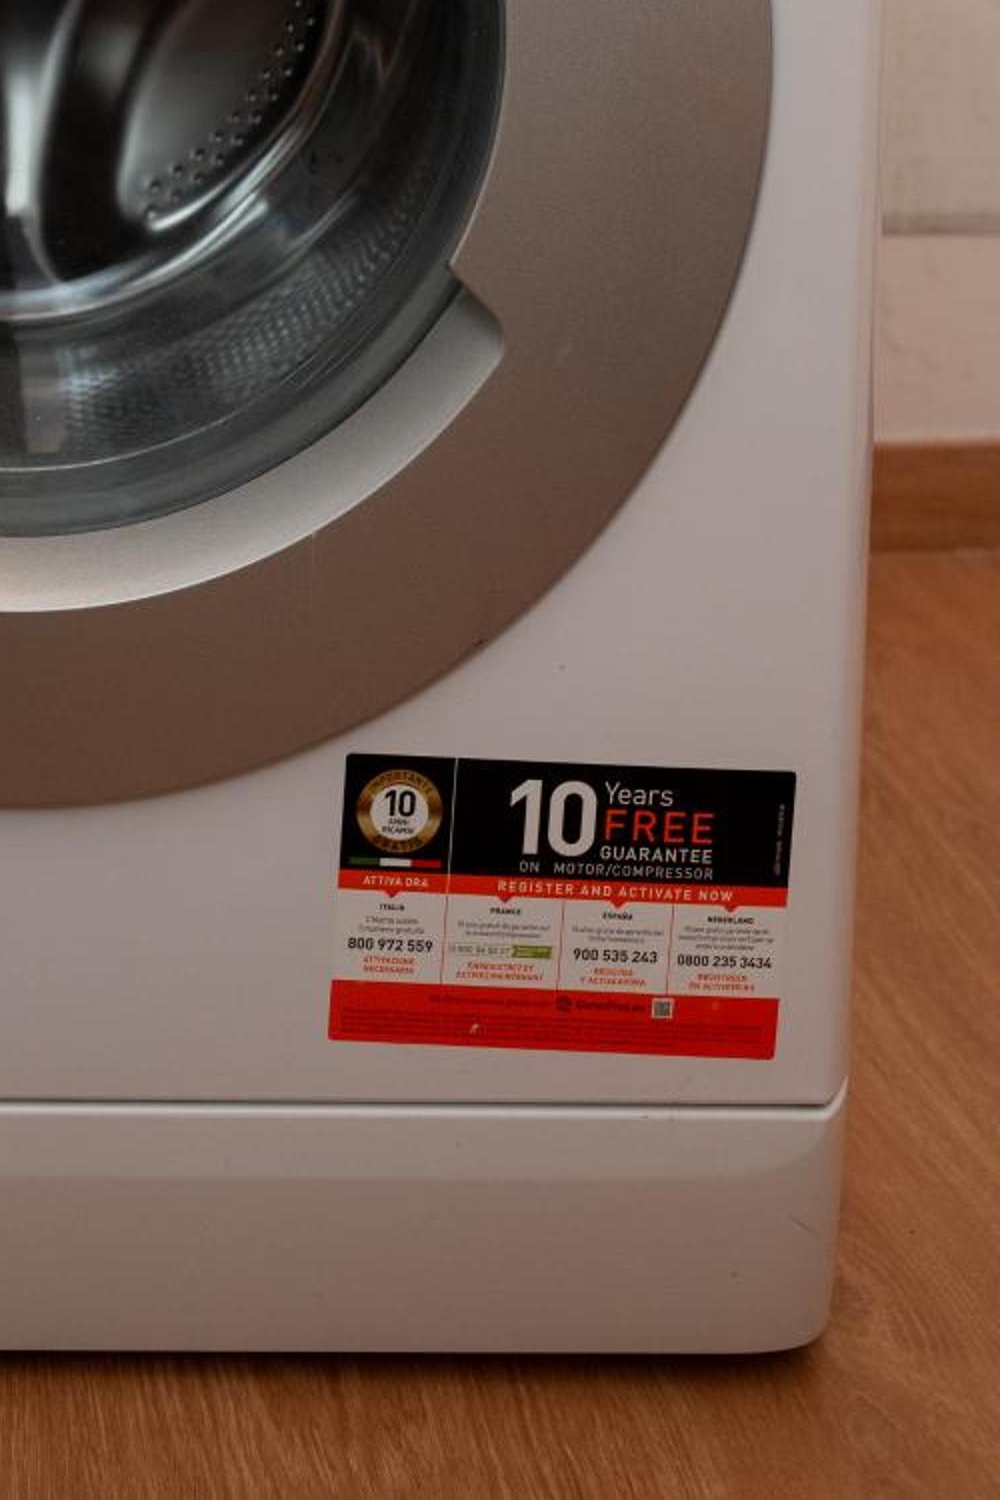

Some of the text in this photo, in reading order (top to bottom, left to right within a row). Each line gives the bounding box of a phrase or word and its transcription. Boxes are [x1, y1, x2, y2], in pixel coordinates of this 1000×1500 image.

[384, 789, 417, 817] 10
[604, 781, 675, 807] Years
[509, 778, 598, 858] 10
[603, 808, 715, 845] FREE
[599, 845, 713, 865] GUARANTEE
[362, 874, 403, 887] ATTIVA
[519, 861, 714, 881] ON MOTOR/COMPRESSOR
[497, 880, 735, 902] REGISTER AND ACTIVATE NOW
[347, 937, 374, 950] 800
[377, 938, 404, 952] 972
[406, 939, 433, 953] 559
[573, 947, 658, 963] 900 535 243
[677, 954, 772, 969] 0800 235 3434
